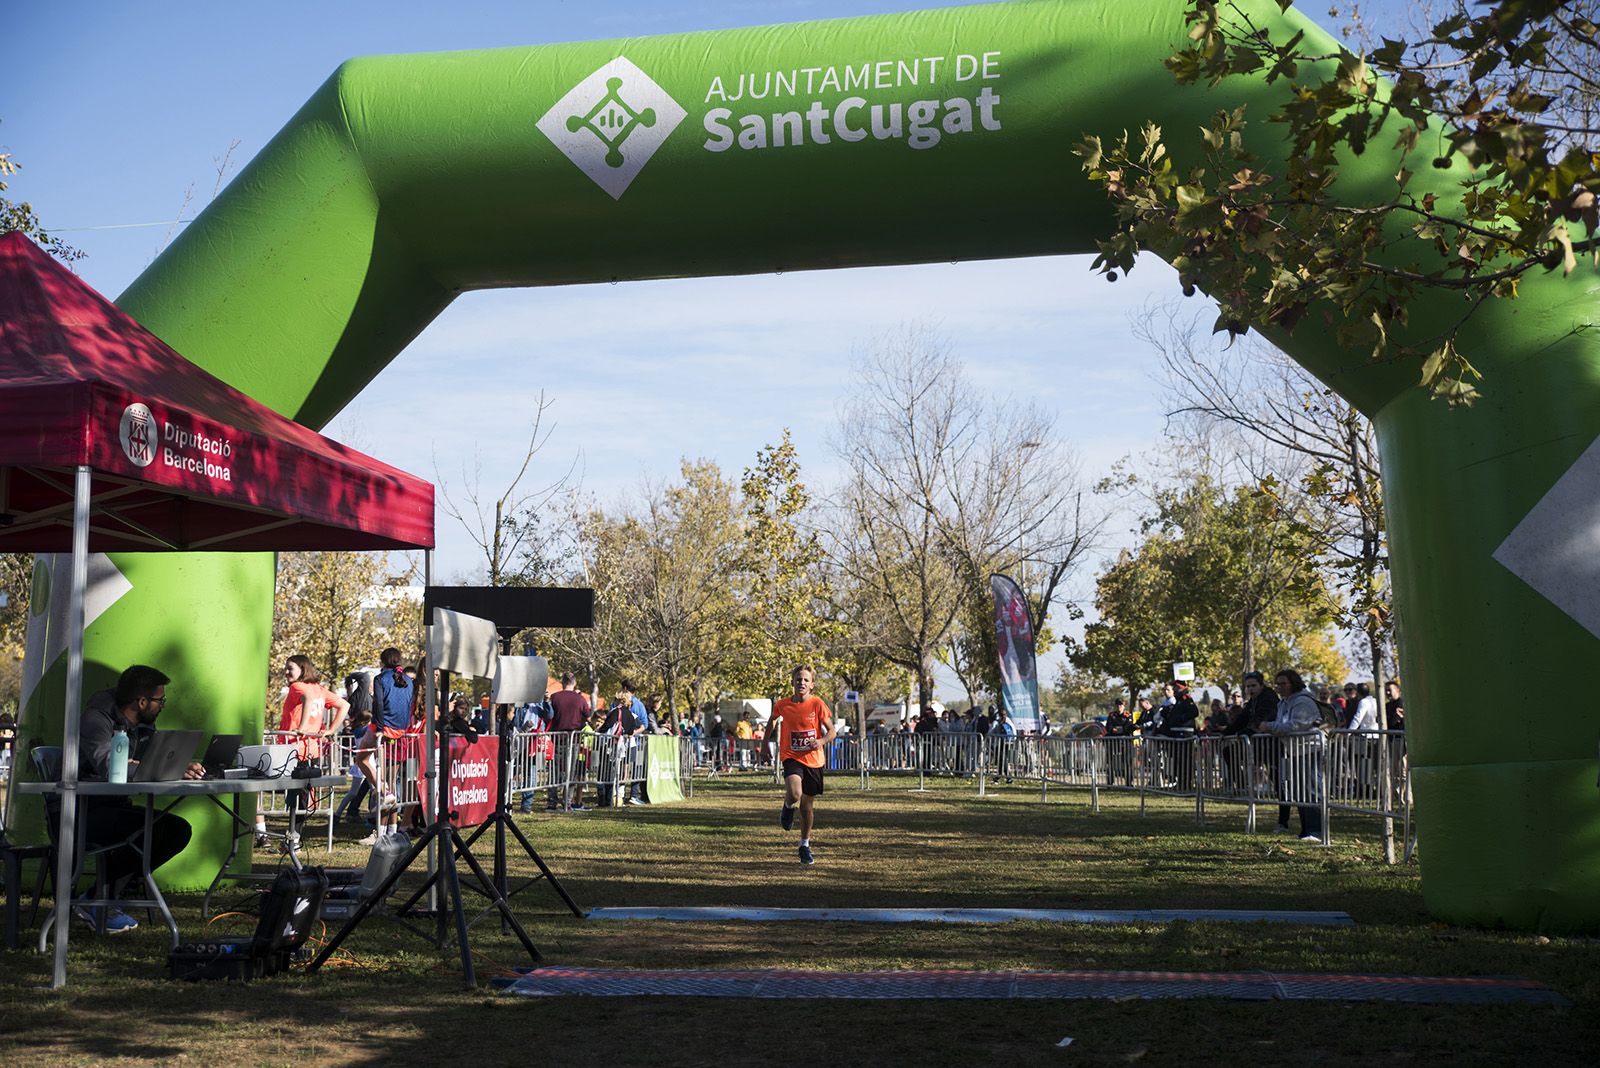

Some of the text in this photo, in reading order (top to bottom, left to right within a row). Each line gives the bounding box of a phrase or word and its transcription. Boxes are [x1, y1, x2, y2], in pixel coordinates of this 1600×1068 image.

[704, 51, 1001, 103] AJUNTAMENT DE
[703, 87, 1002, 152] SantCugat
[164, 421, 231, 457] Diputació
[164, 447, 231, 481] Barcelona
[451, 758, 489, 782] Diputació
[452, 785, 488, 806] Barcelona
